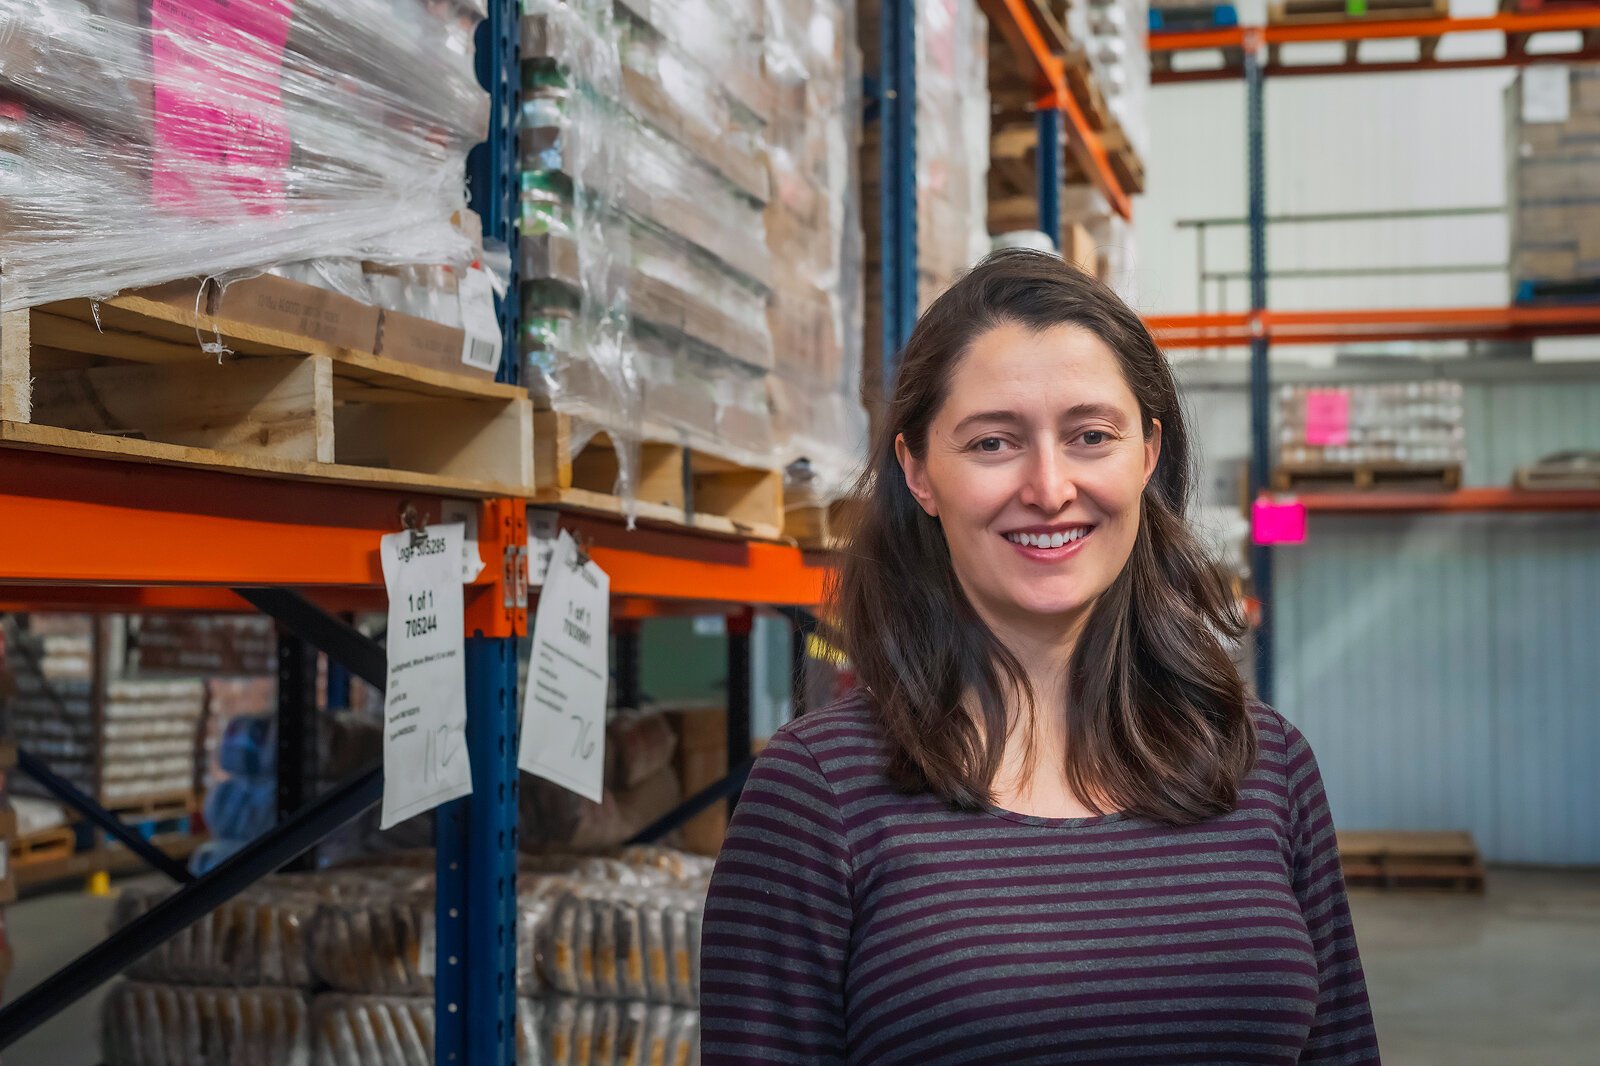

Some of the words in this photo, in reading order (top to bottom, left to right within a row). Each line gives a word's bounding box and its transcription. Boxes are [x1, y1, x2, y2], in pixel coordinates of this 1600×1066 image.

[407, 593, 414, 613] 1
[417, 589, 426, 611] of
[428, 589, 434, 609] 1
[575, 607, 586, 623] of
